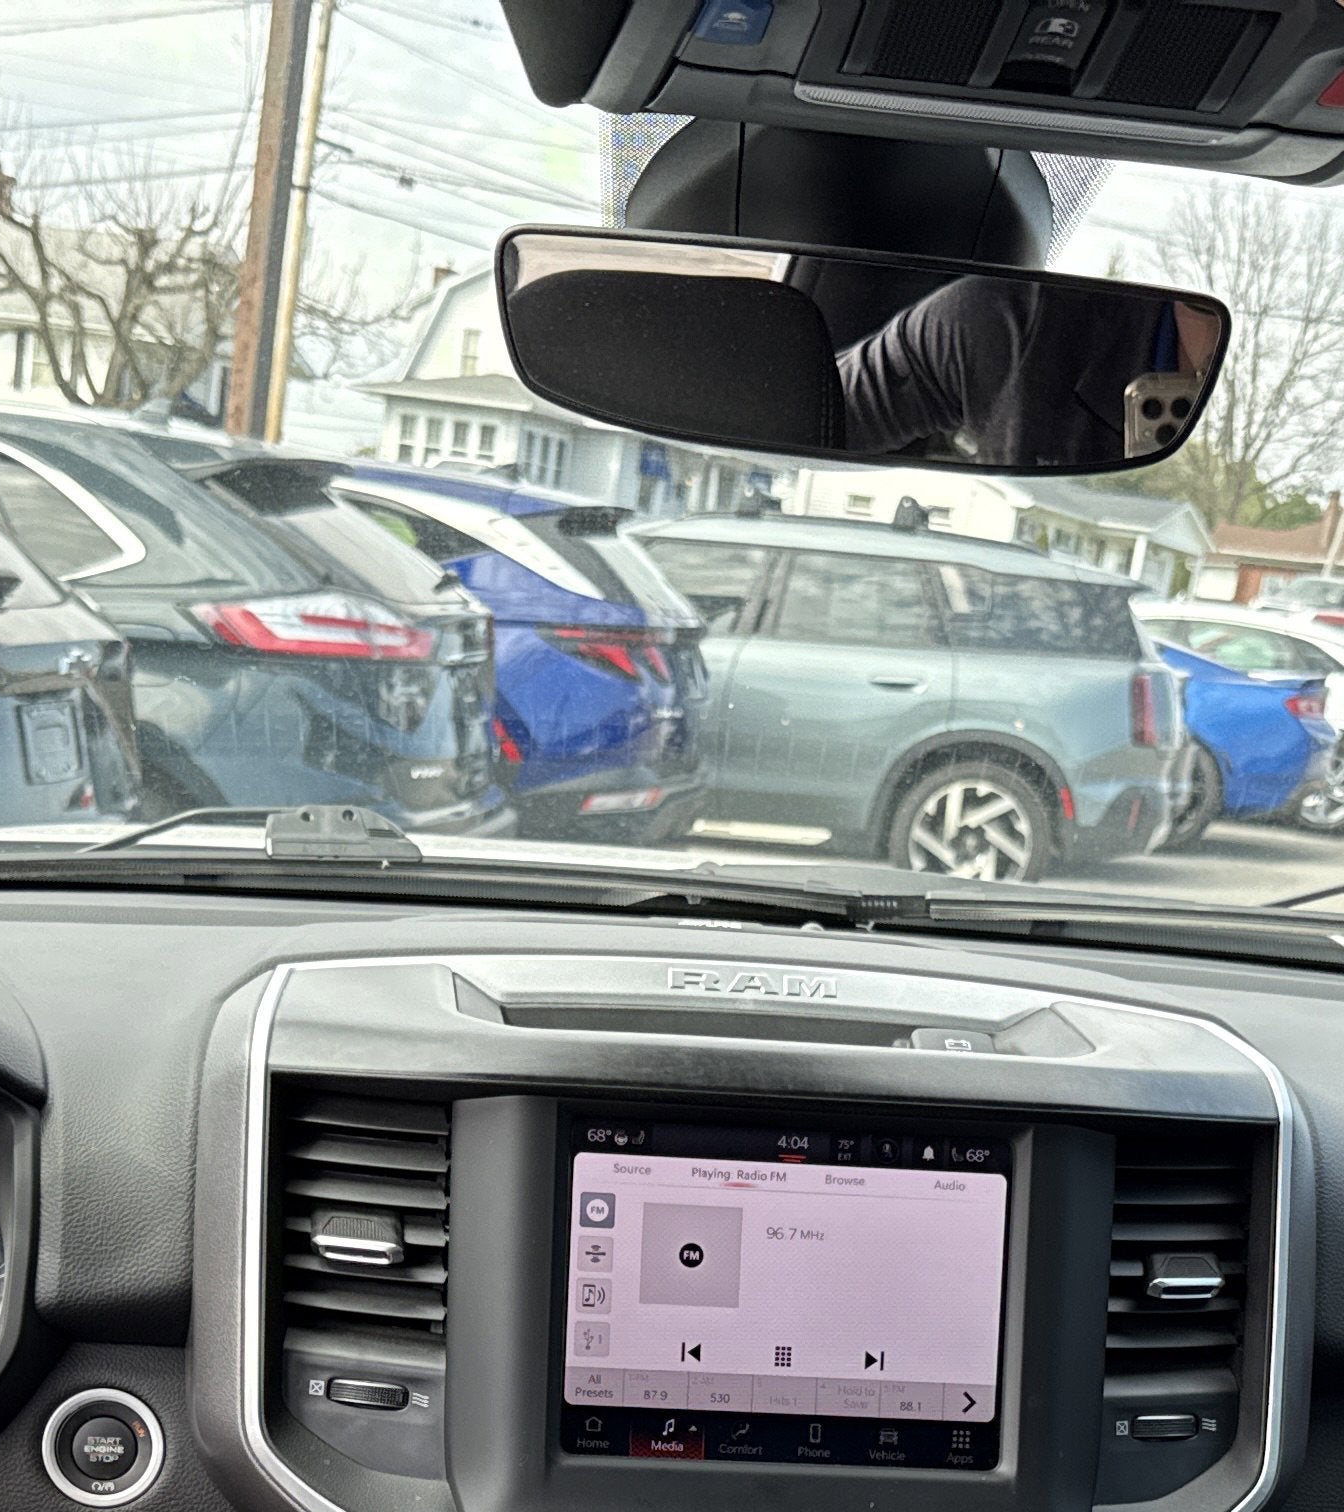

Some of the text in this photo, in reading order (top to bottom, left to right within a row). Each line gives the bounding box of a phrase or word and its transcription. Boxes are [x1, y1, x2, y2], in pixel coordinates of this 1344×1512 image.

[668, 967, 838, 999] RAM
[777, 1136, 809, 1149] 4:04
[613, 1163, 652, 1175] Source
[691, 1168, 787, 1182] Playing Radio FM
[825, 1174, 865, 1186] Browse
[934, 1180, 966, 1191] Audio
[590, 1206, 605, 1215] FM
[800, 1230, 825, 1241] MHz
[683, 1250, 700, 1261] FM
[588, 1374, 602, 1385] All
[575, 1387, 613, 1399] Presets
[710, 1393, 731, 1404] 530
[900, 1401, 921, 1412] 88.1
[87, 1436, 122, 1446] START
[576, 1438, 610, 1449] Home
[651, 1440, 684, 1452] Media
[84, 1445, 125, 1455] ENGINE
[719, 1444, 763, 1456] Comfort
[798, 1446, 831, 1458] Phone
[869, 1449, 906, 1462] Vehicle
[89, 1454, 119, 1463] STOP
[946, 1452, 974, 1465] Apps
